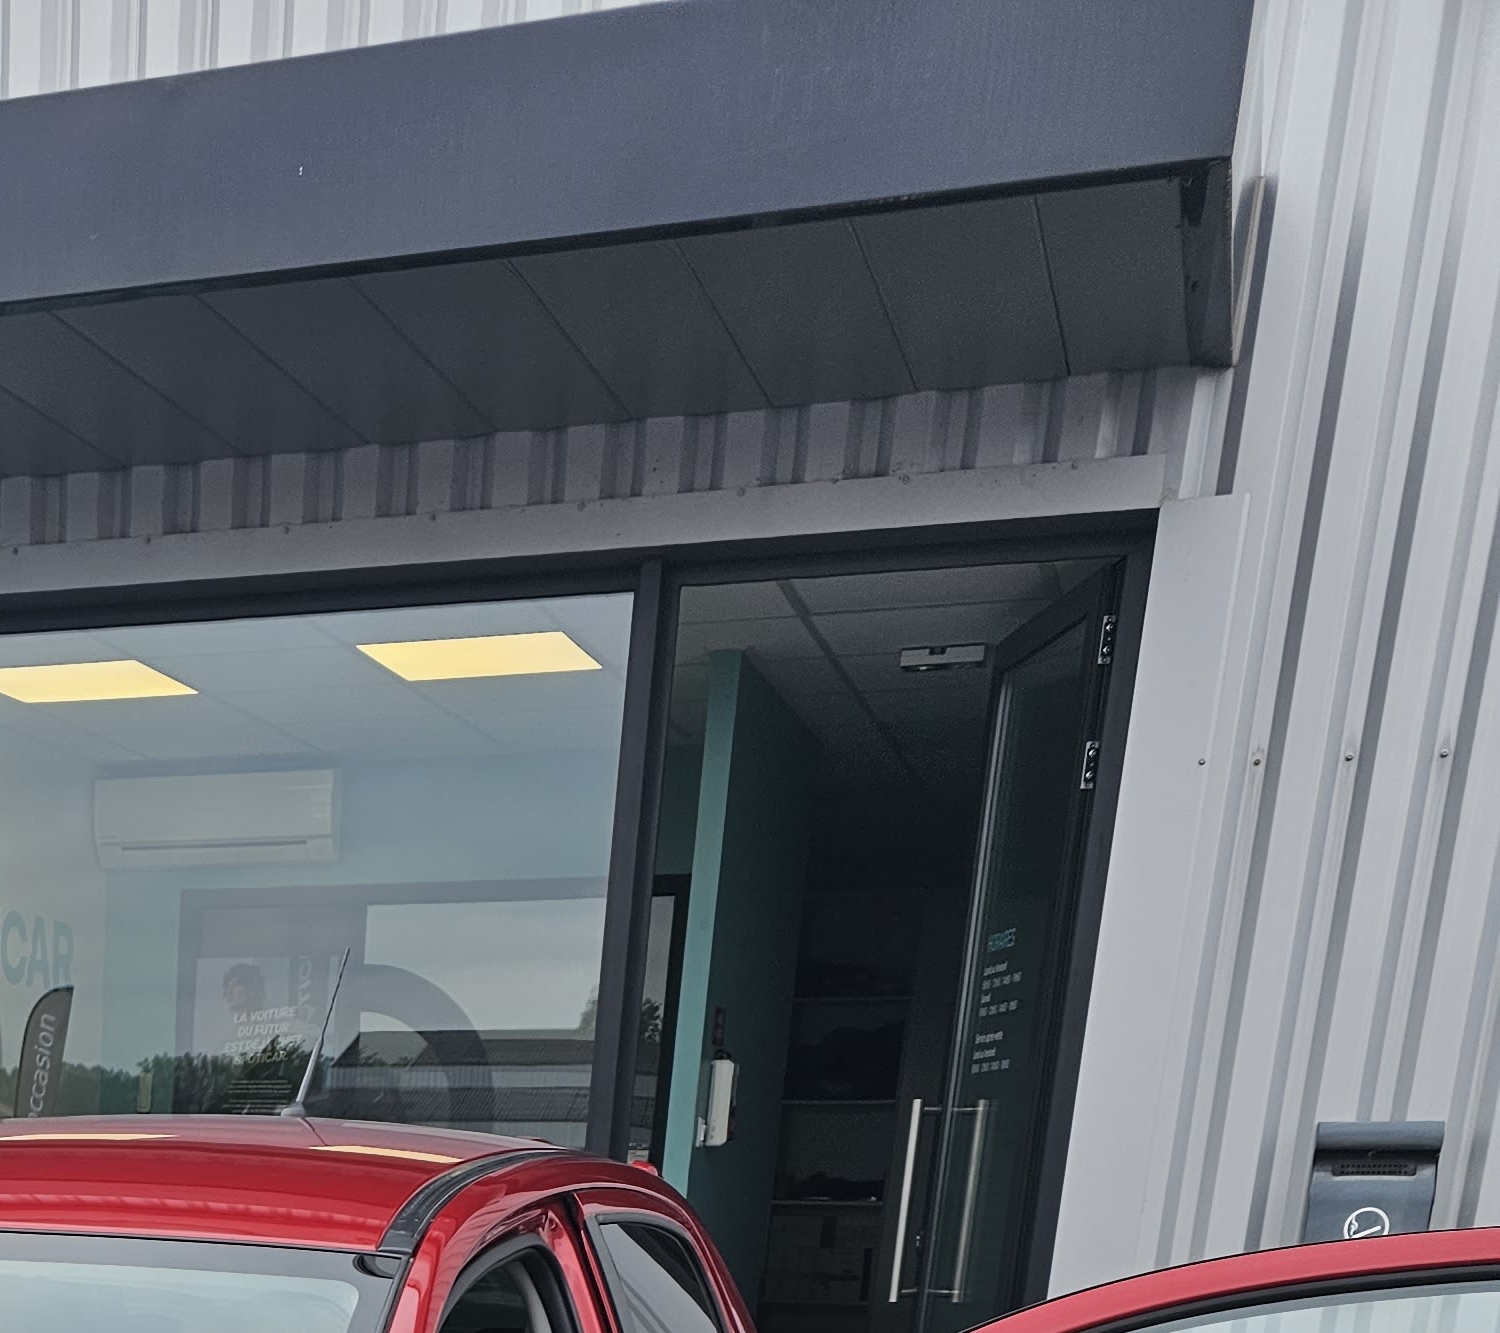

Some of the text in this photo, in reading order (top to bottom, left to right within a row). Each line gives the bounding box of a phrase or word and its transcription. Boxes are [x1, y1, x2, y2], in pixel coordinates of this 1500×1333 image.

[234, 1006, 297, 1023] LA VOITURE
[237, 1022, 290, 1038] DU FUTUR
